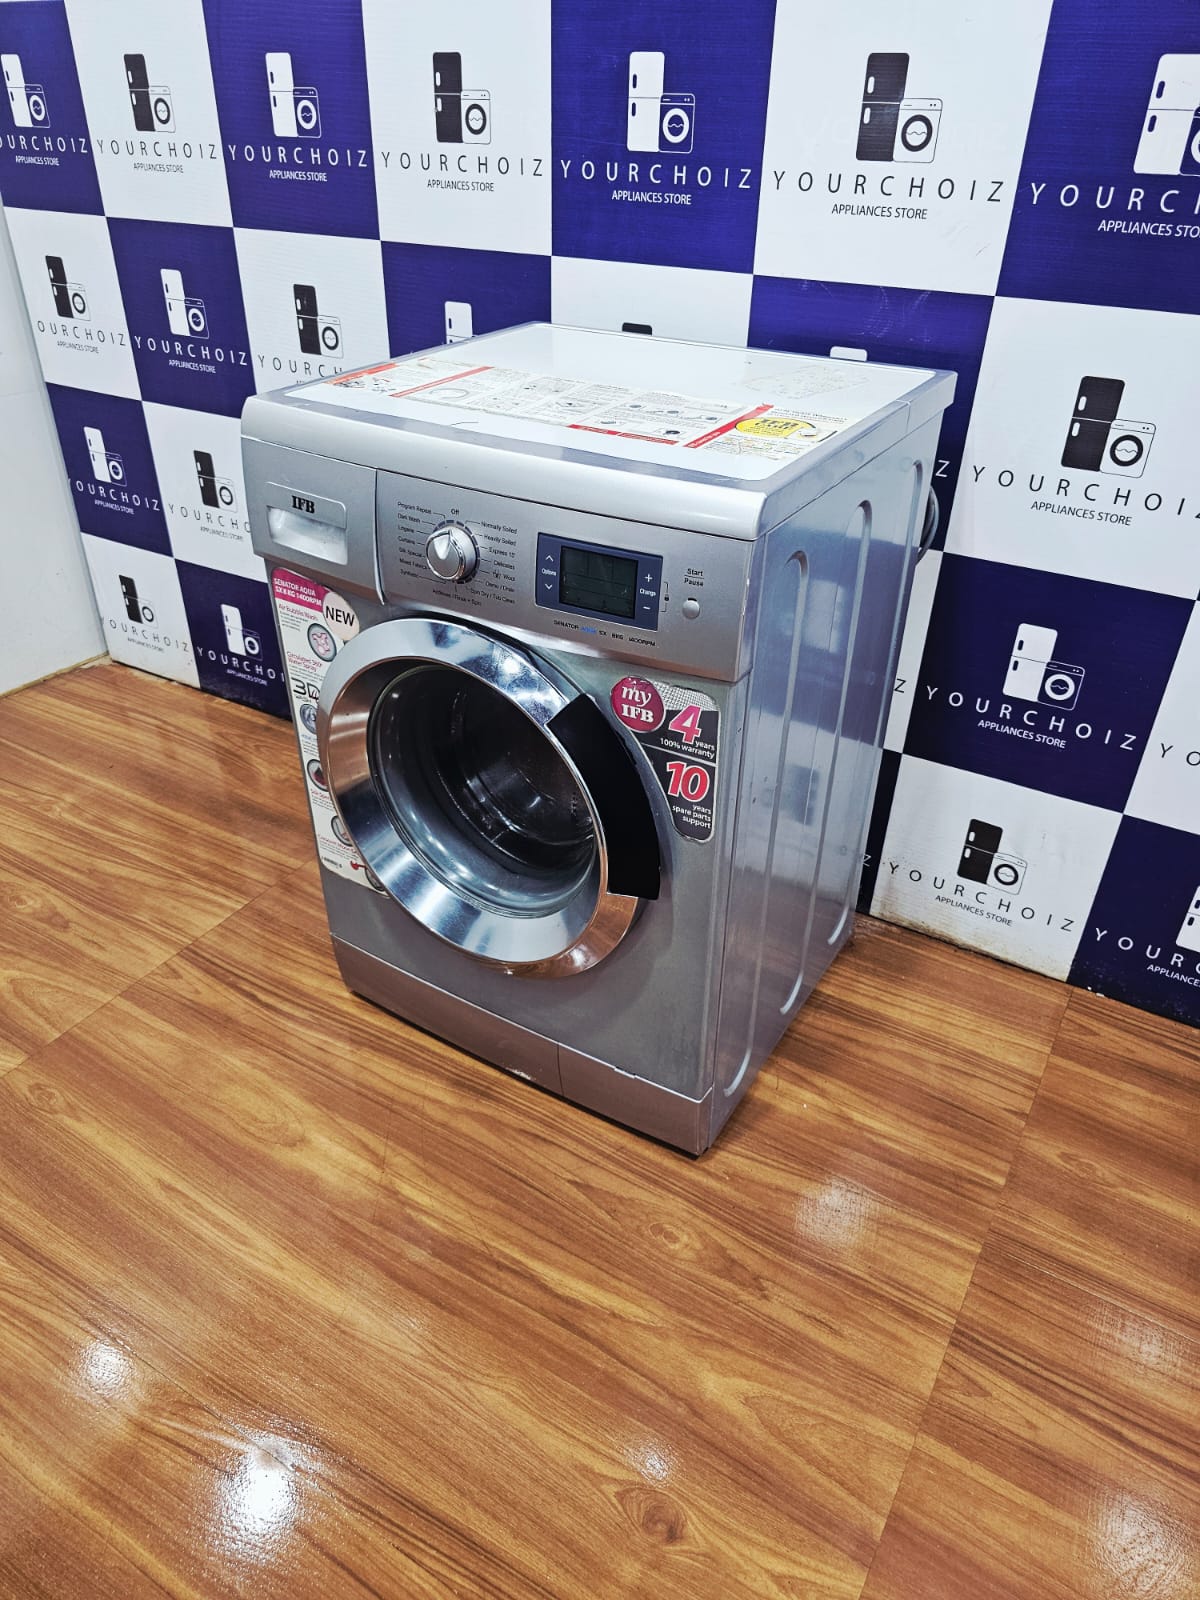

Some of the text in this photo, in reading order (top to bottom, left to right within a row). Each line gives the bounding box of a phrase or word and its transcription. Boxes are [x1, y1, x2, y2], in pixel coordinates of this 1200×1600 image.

[97, 139, 217, 160] YOURCHOIZ
[229, 145, 367, 167] YOURCHOIZ
[16, 155, 60, 166] APPLIANCES STORE
[133, 162, 184, 175] APPLIANCES STORE
[381, 151, 543, 177] YOURCHOIZ
[269, 169, 327, 182] APPLIANCES STORE
[560, 159, 751, 189] YOURCHOIZ
[427, 179, 494, 192] APPLIANCES STORE
[773, 170, 1004, 203] YOURCHOIZ
[611, 189, 692, 205] APPLIANCES STORE
[831, 204, 928, 220] APPLIANCES STORE
[1097, 219, 1173, 236] APPLIANCES
[134, 336, 248, 366] YOURCHOIZ
[168, 359, 216, 374] APPLIANCES STORE
[292, 495, 315, 514] IFB
[1030, 500, 1133, 527] APPLIANCES STORE
[481, 521, 517, 534] Normally Soiled
[489, 546, 507, 556] Express
[541, 568, 557, 577] Options
[687, 568, 703, 577] Start
[274, 578, 316, 597] SENATOR AQUA
[684, 577, 704, 587] Pause
[296, 592, 322, 606] 1400RPM
[639, 588, 656, 597] Change
[325, 605, 355, 627] NEW
[553, 620, 579, 630] SENATOR
[622, 686, 652, 707] my
[621, 704, 654, 723] IFB
[925, 685, 1137, 750] YOURCHOIZ
[668, 704, 701, 745] 4
[977, 718, 1067, 749] APPLIANCES STORE
[660, 737, 715, 760] 100% warranty
[695, 740, 715, 751] years
[666, 761, 710, 802] 10
[672, 805, 711, 822] spare parts
[693, 804, 712, 815] years
[683, 816, 712, 829] support
[889, 861, 1075, 932] YOURCHOIZ
[935, 895, 1013, 927] APPLIANCES STORE
[1147, 964, 1200, 988] APPLIANCE
